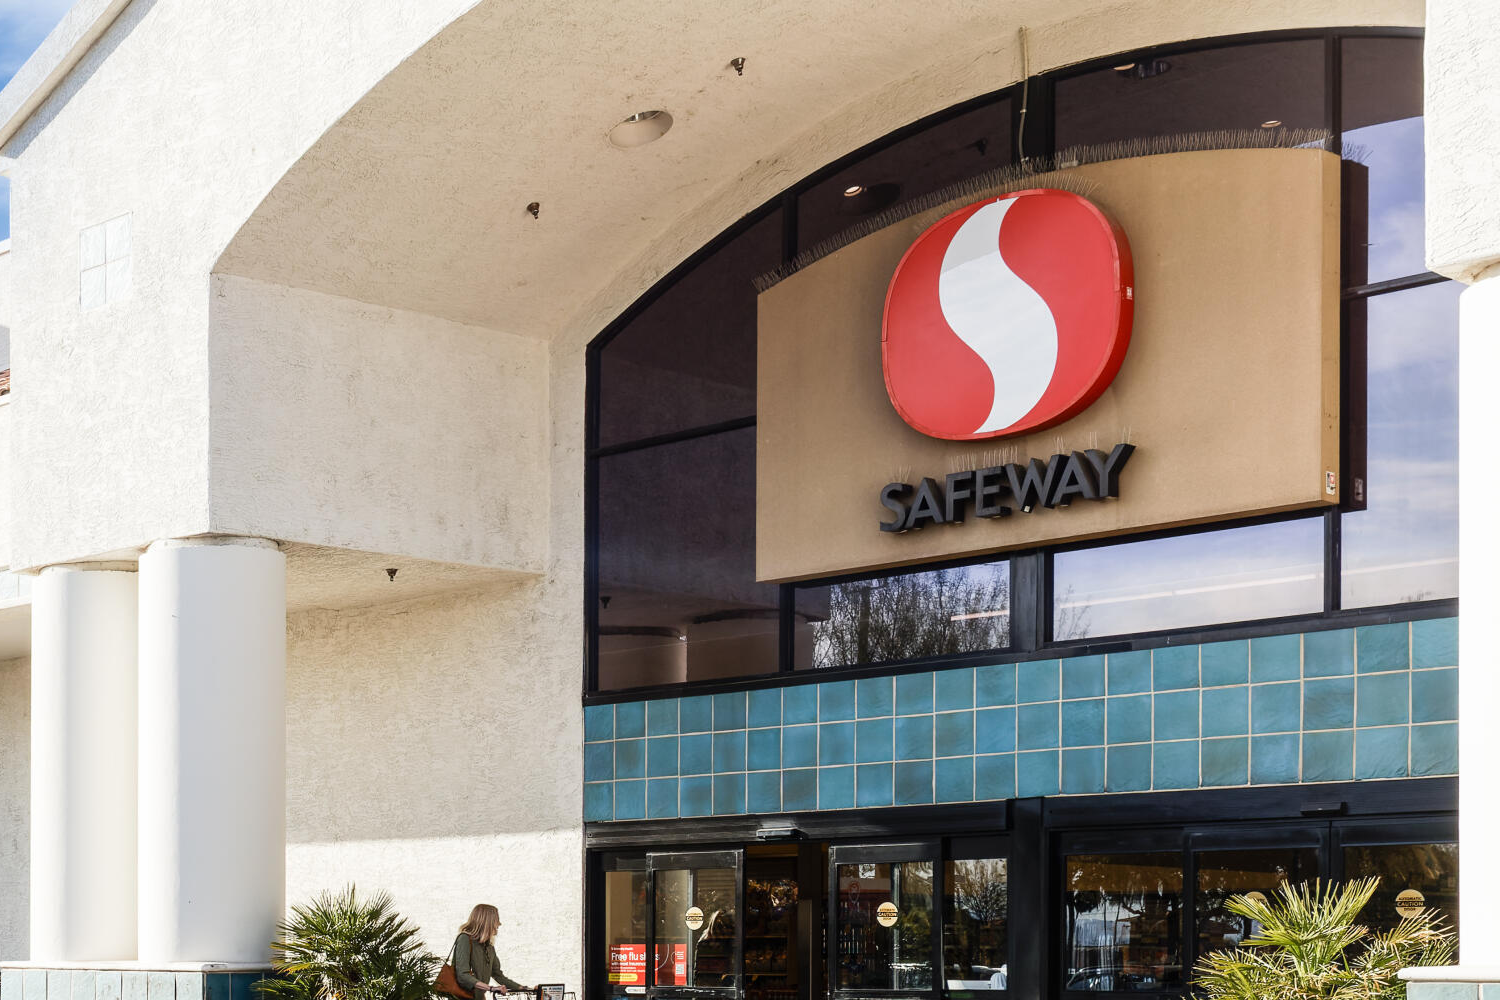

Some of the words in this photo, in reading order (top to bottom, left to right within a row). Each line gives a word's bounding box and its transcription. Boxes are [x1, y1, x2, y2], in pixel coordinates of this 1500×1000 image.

[880, 443, 1136, 533] SAFEWAY
[611, 952, 628, 961] Free
[628, 951, 639, 961] flu
